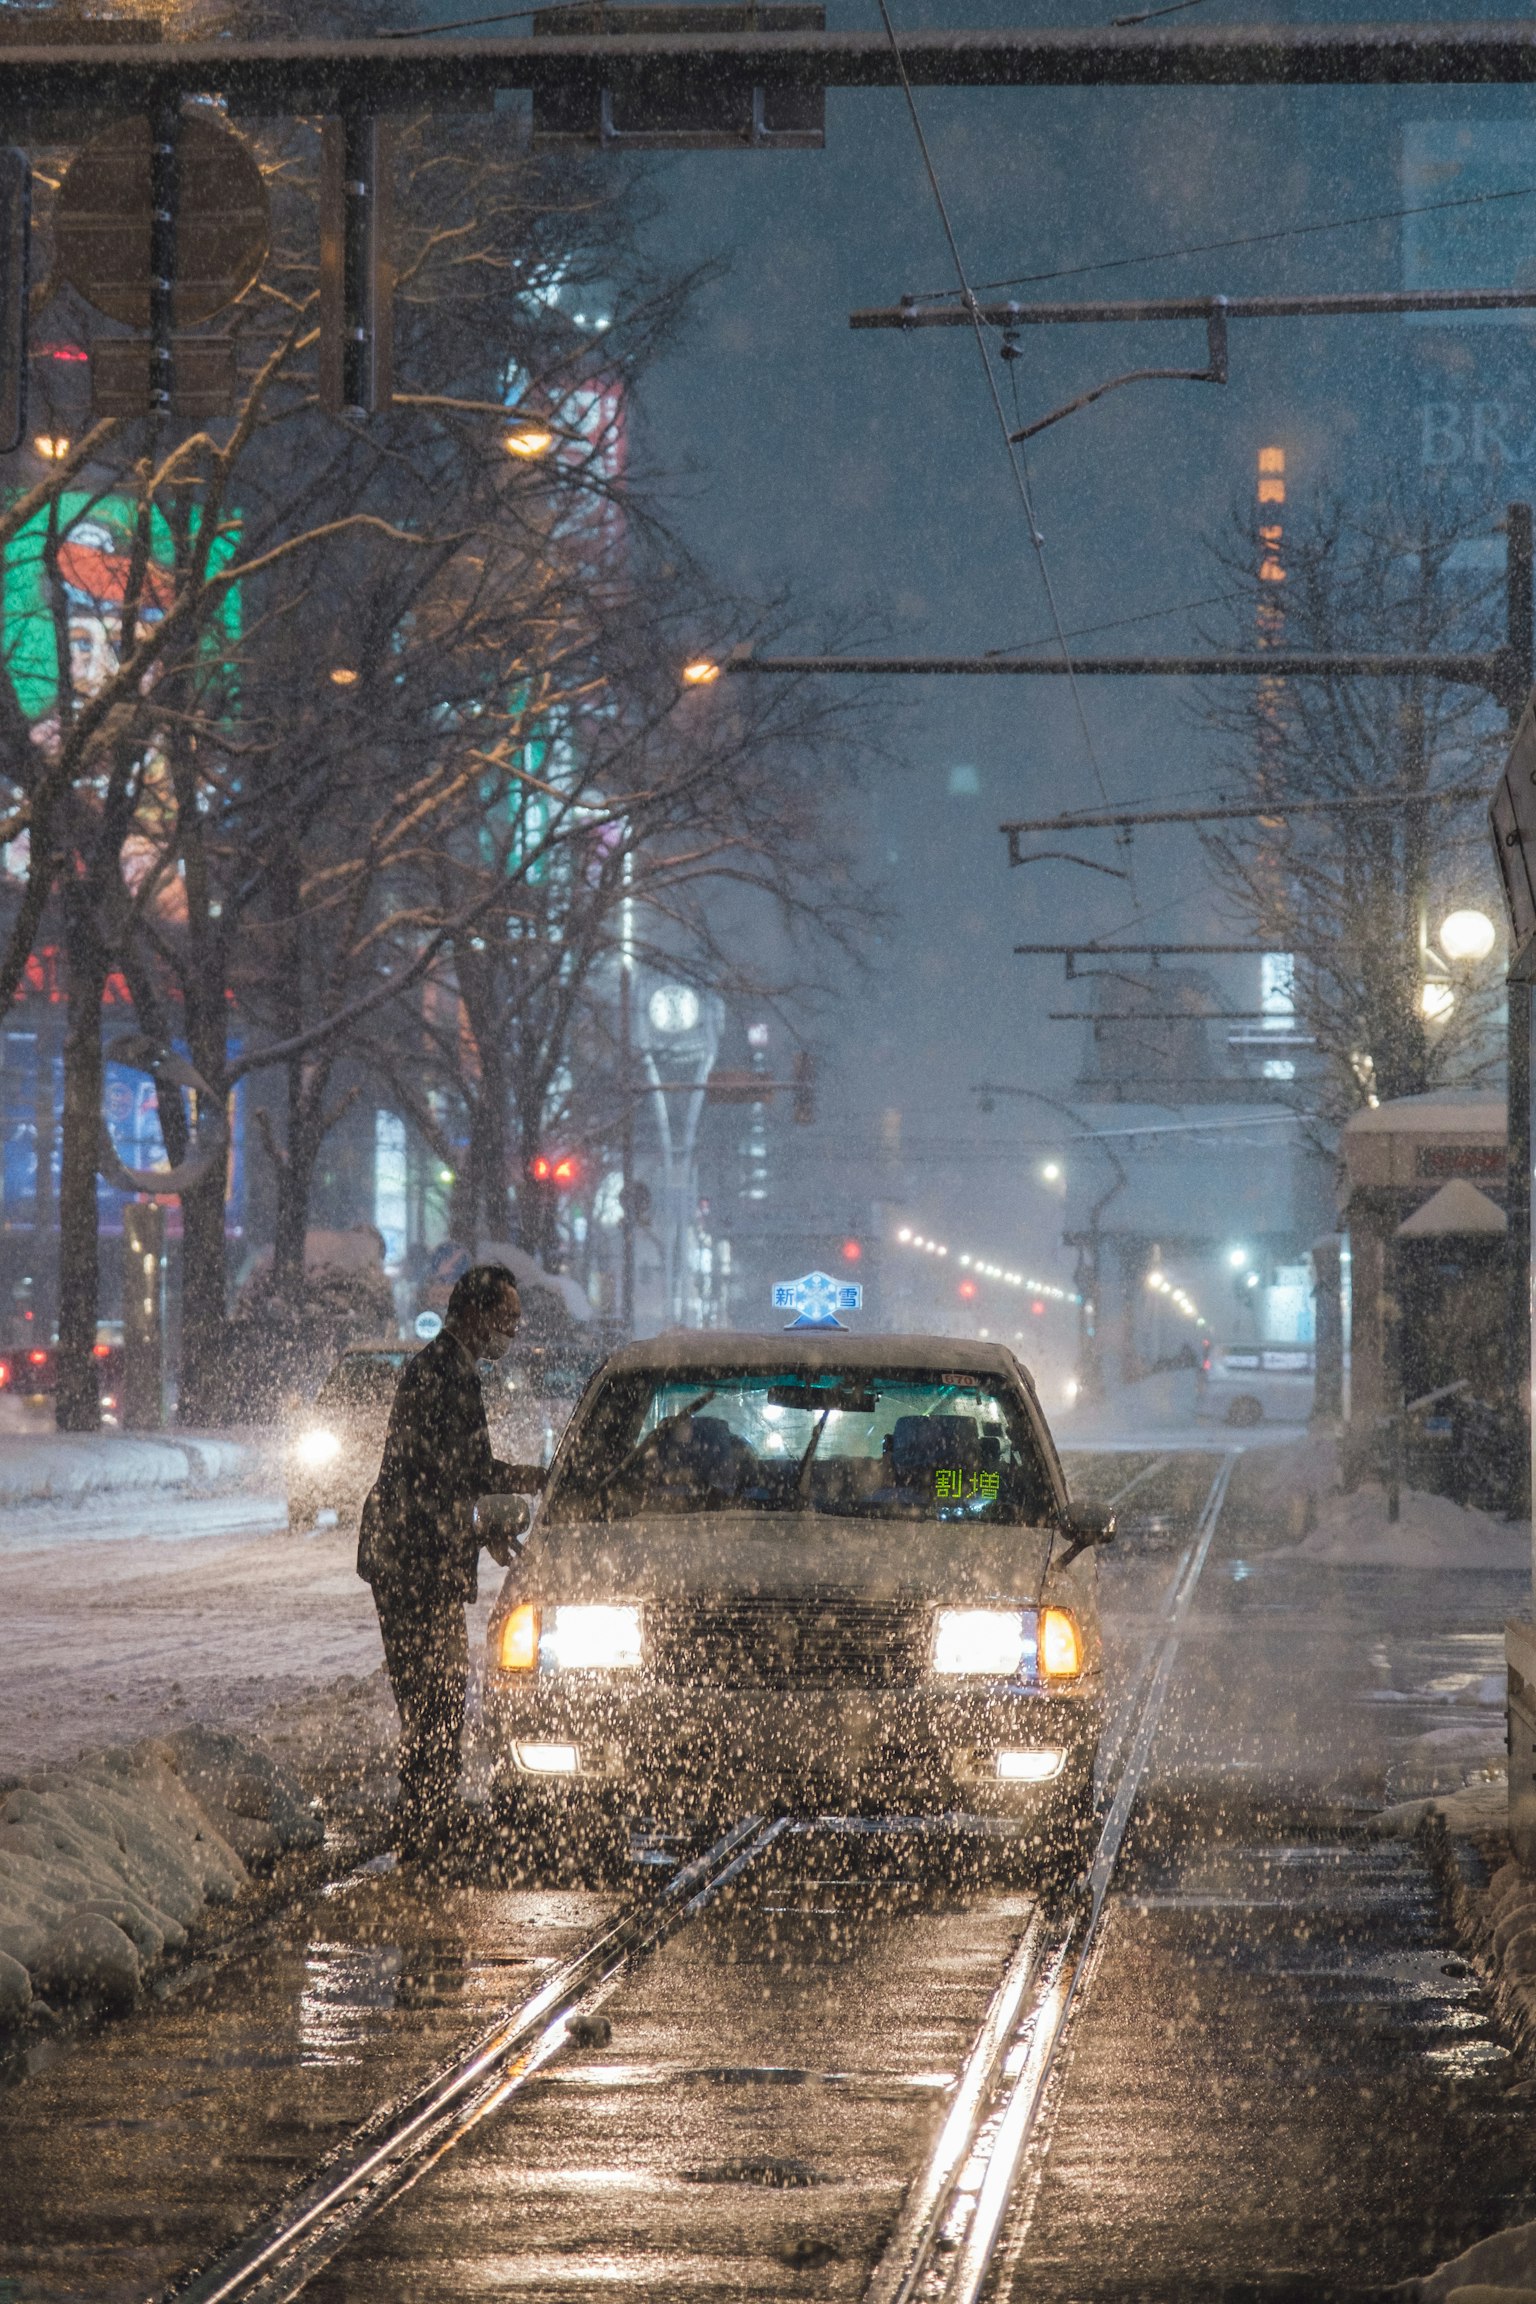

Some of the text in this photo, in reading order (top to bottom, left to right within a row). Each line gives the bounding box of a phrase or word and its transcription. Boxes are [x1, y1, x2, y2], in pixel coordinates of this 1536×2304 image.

[775, 1287, 858, 1307] 新 雪
[944, 1374, 974, 1386] 670
[935, 1468, 1000, 1500] 割増
